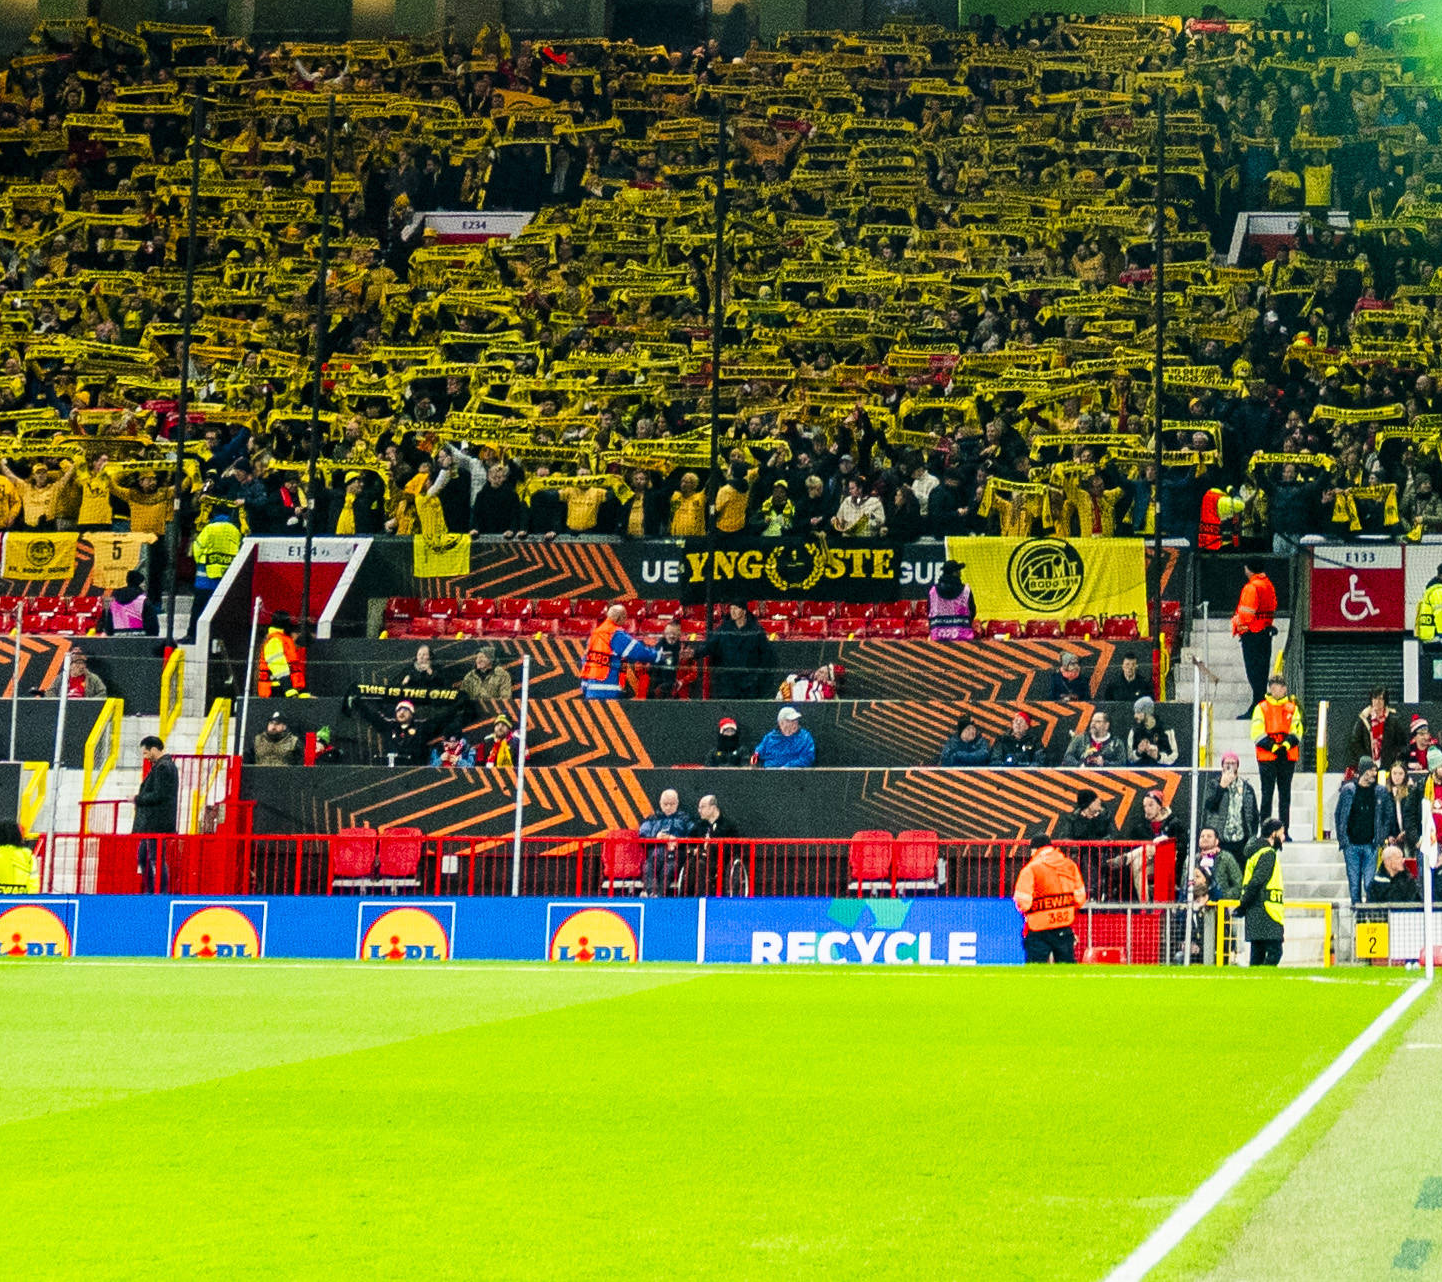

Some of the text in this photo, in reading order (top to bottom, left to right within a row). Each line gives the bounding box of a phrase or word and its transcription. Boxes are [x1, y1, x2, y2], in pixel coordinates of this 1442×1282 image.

[461, 219, 487, 231] E234
[111, 540, 123, 562] 5
[1345, 551, 1376, 564] E133
[685, 547, 895, 584] YNG STE
[357, 683, 458, 700] THIS IS THE ONE
[751, 931, 978, 965] RECYCLE
[1368, 936, 1377, 955] 2
